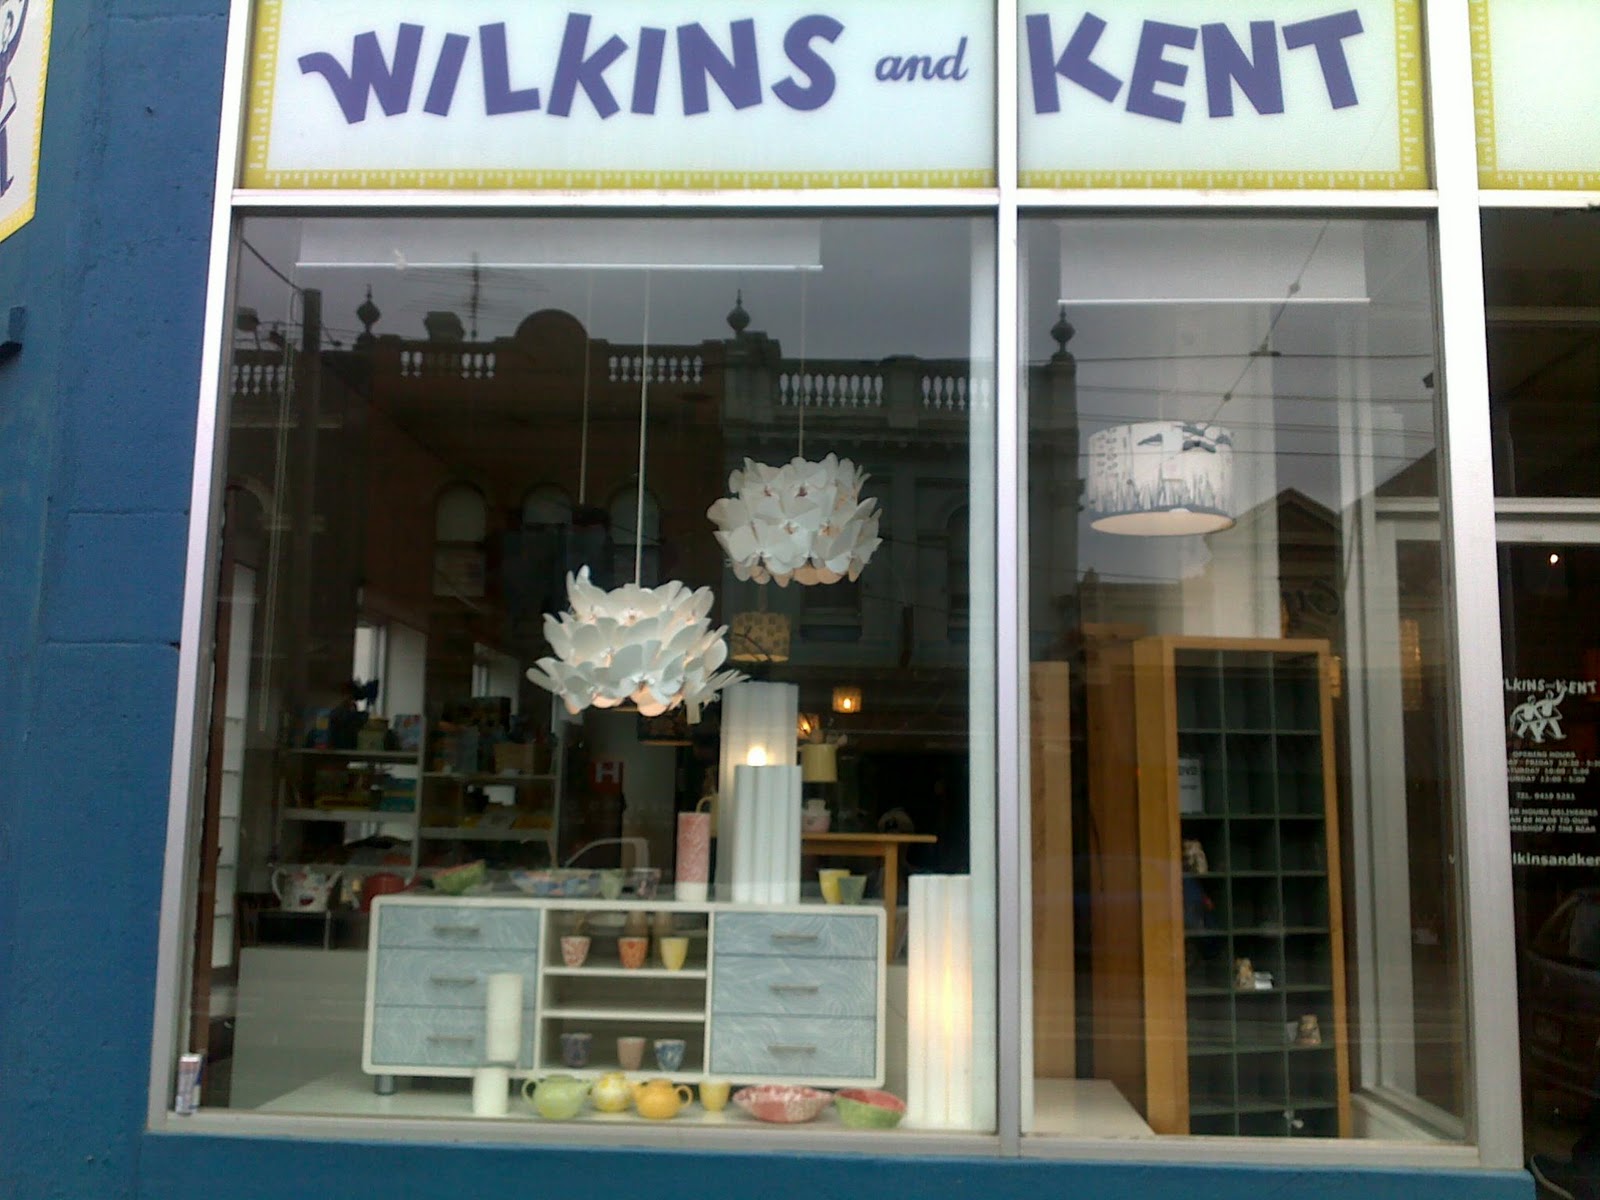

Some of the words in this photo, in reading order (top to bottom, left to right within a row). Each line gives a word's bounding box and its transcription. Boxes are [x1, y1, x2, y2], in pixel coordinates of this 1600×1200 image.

[299, 12, 844, 125] WILKINS
[875, 37, 968, 82] and
[1026, 9, 1364, 125] KENT
